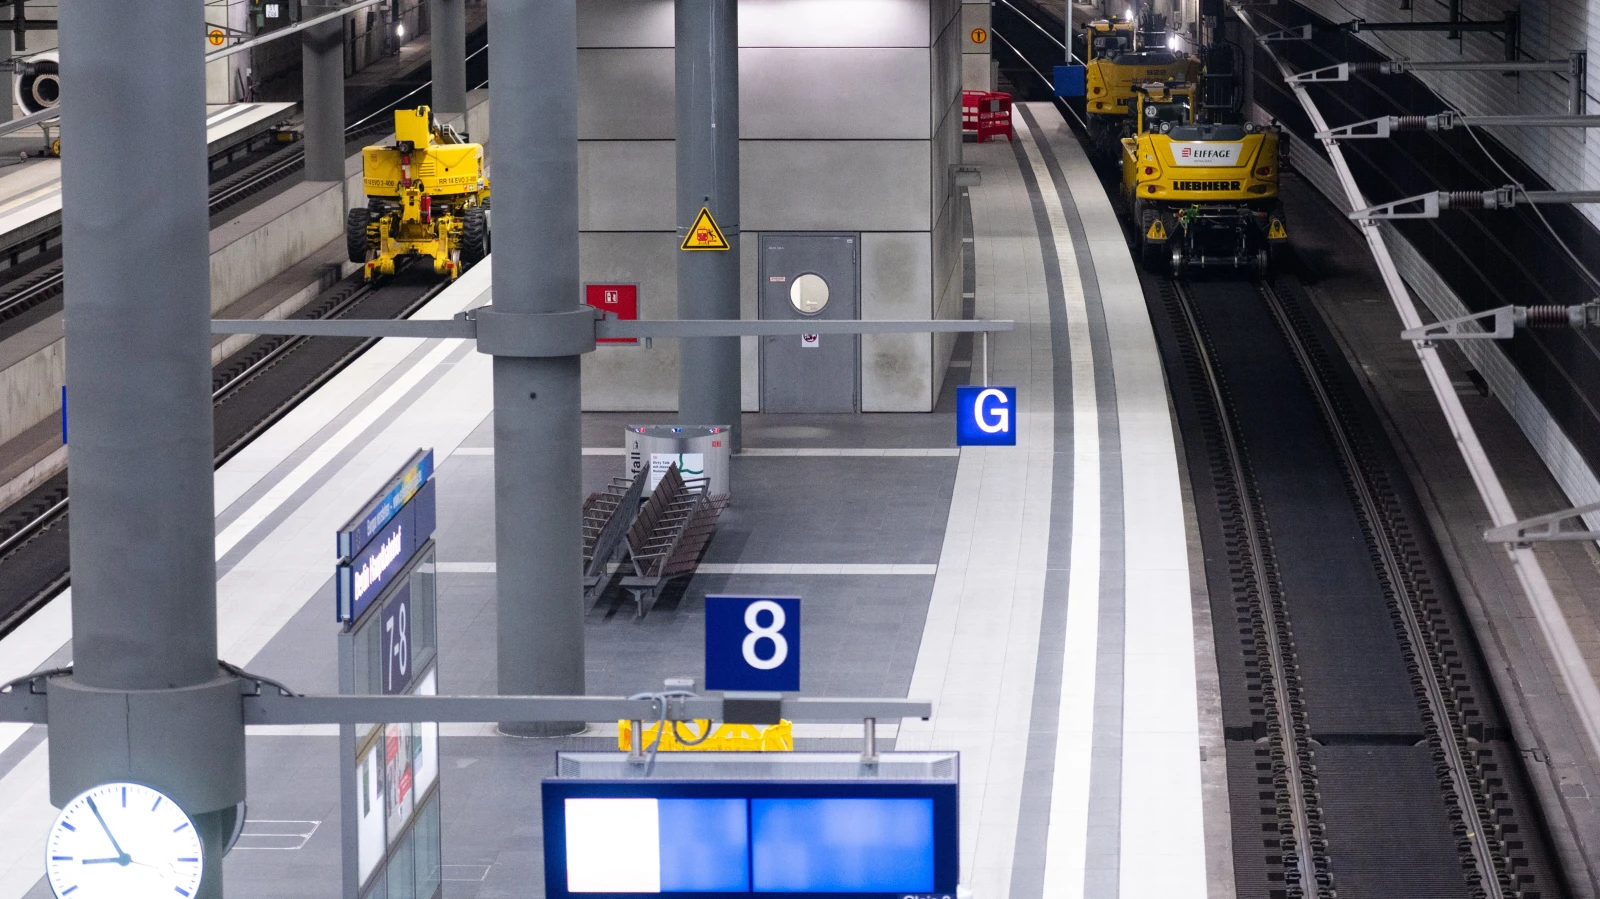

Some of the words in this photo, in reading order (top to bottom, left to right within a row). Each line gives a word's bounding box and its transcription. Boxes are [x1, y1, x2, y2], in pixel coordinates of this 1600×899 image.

[1147, 106, 1156, 115] 20
[1194, 150, 1231, 158] EIFFAGE
[1173, 181, 1240, 191] LIEBHERR
[974, 388, 1009, 434] G
[630, 452, 641, 481] fall
[386, 602, 408, 691] 7-8
[742, 600, 788, 670] 8
